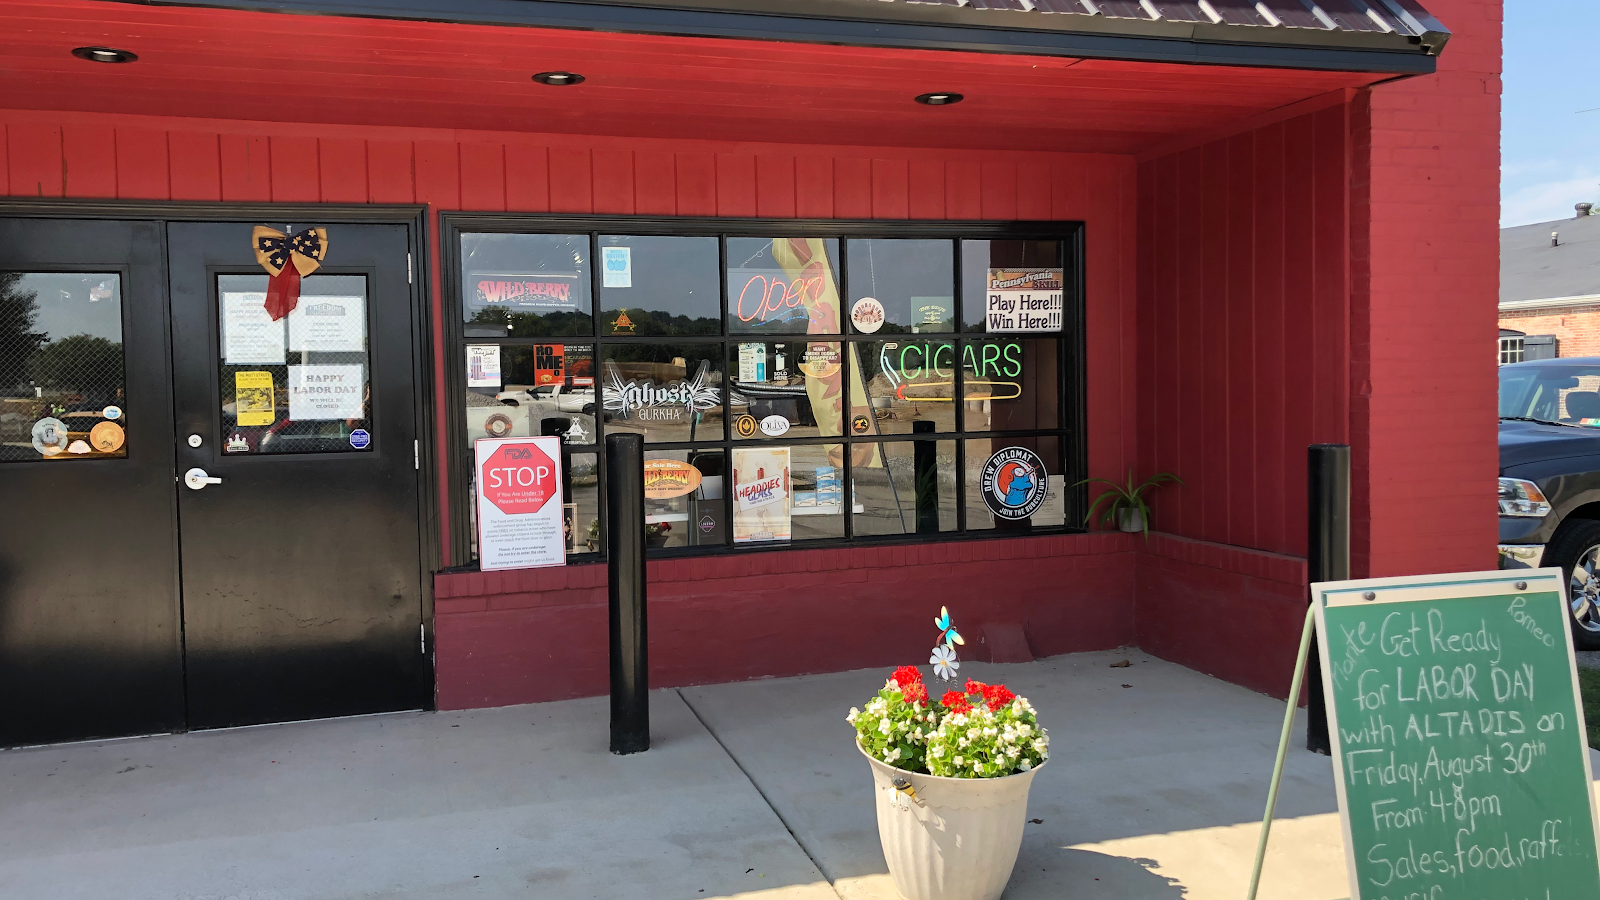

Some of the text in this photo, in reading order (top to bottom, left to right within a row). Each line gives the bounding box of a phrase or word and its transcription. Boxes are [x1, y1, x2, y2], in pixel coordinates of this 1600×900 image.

[991, 269, 1052, 289] Pennsylvania
[1033, 280, 1062, 290] SKILL
[478, 280, 570, 302] WILD BERRY
[738, 275, 823, 322] Open
[989, 294, 1061, 314] Play Here!!!
[989, 312, 1060, 329] Win Here!!!
[536, 345, 553, 356] RO
[900, 343, 1021, 380] CIGARS
[536, 356, 563, 370] ME
[626, 382, 690, 409] ghost
[638, 408, 681, 420] GURKHA
[760, 419, 788, 432] OLIVA
[505, 448, 533, 460] FDA
[490, 466, 549, 488] STOP
[660, 470, 690, 484] BERRY
[984, 450, 1032, 492] DREW DIPLOMAT
[748, 487, 773, 502] GLASS
[999, 478, 1045, 516] JOIN THE SUBCULTURE
[1507, 597, 1555, 647] Romeo
[1380, 608, 1502, 665] Get Ready
[1352, 662, 1534, 712] for LABOR DAY
[1341, 708, 1565, 746] with ALTADIS on
[1501, 740, 1546, 774] 30th
